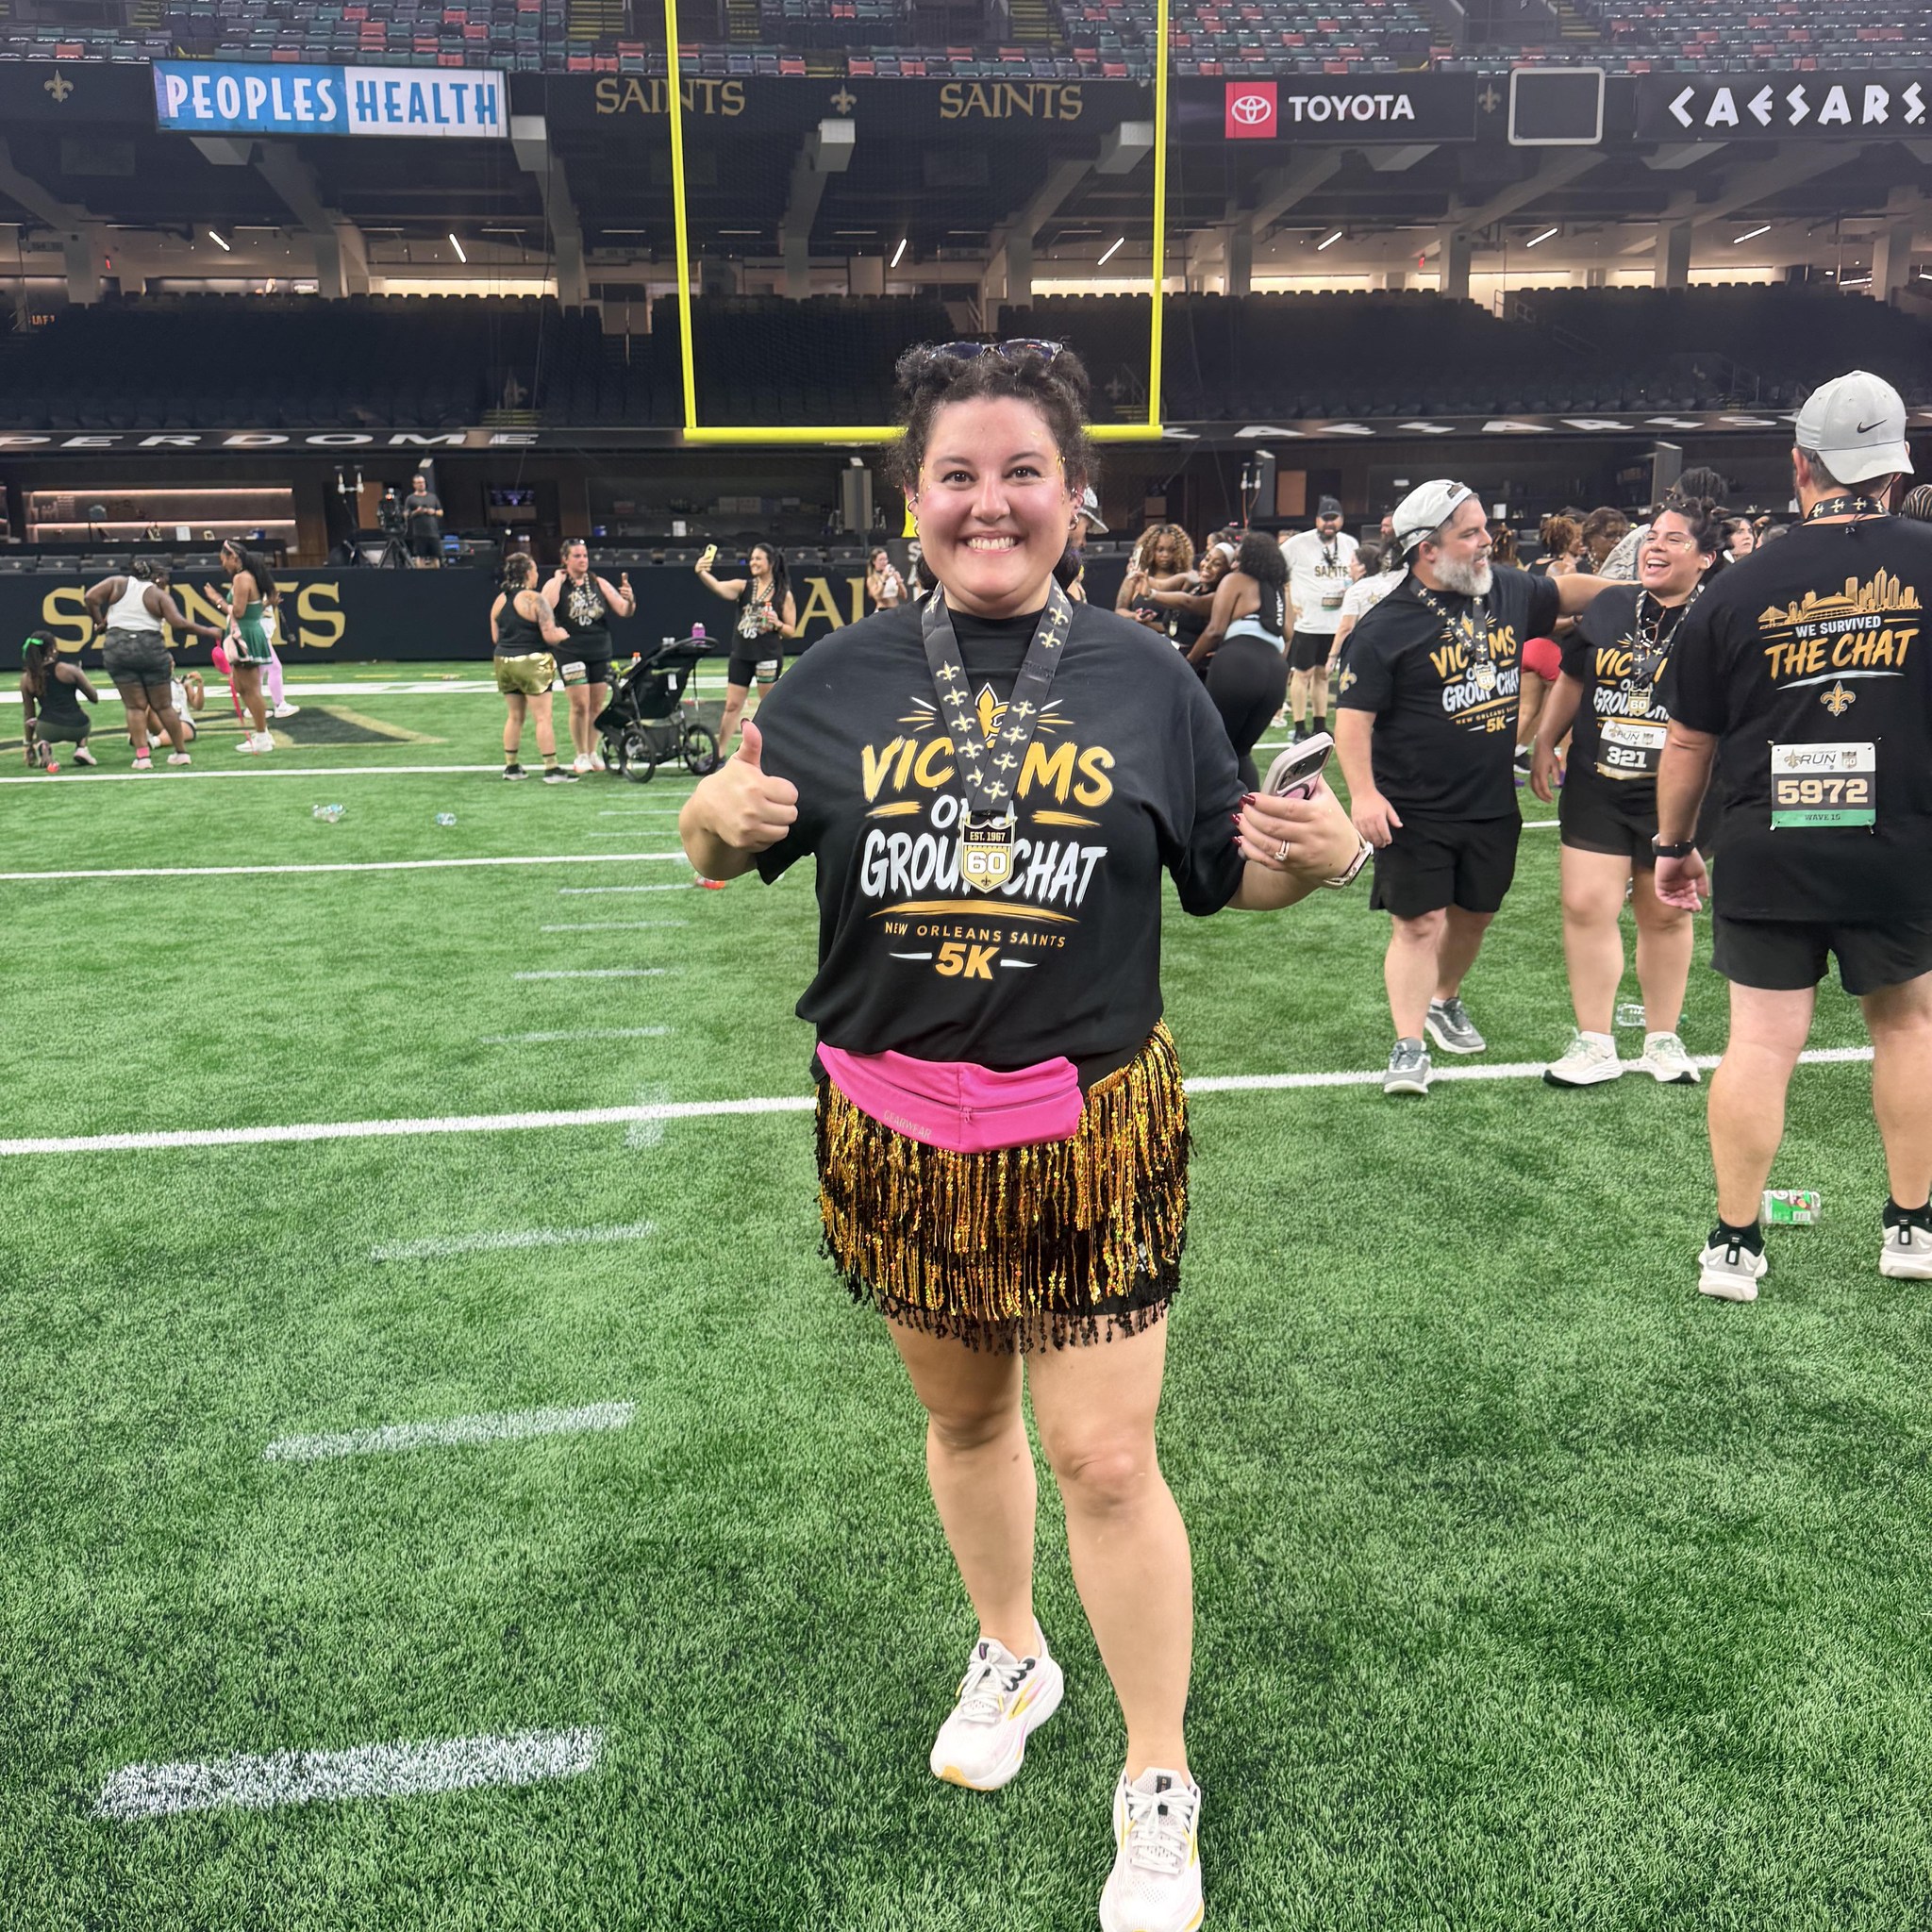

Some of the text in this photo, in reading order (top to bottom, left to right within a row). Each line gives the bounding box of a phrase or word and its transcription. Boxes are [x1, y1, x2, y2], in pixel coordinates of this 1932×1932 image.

[165, 75, 497, 125] PEOPLES HEALTH
[595, 78, 745, 116] SAINTS
[940, 83, 1083, 121] SAINTS
[1288, 94, 1415, 122] TOYOTA
[1668, 81, 1926, 128] CAESARS
[1795, 615, 1881, 638] WE SURVIVED
[1429, 625, 1517, 678] VICMS
[1764, 628, 1920, 680] THE CHAT
[1486, 715, 1507, 733] 5K
[860, 734, 1116, 808] VICMS
[1606, 745, 1647, 769] 321
[1799, 754, 1837, 765] RUN
[1777, 778, 1868, 805] 5972
[970, 831, 1006, 842] EST. 1967
[860, 828, 1108, 908] GROU CHAT
[966, 850, 1008, 875] 60
[885, 922, 1066, 948] NEW ORLEANS SAINTS
[935, 941, 1000, 980] 5K
[883, 1108, 933, 1141] GEARWEAR
